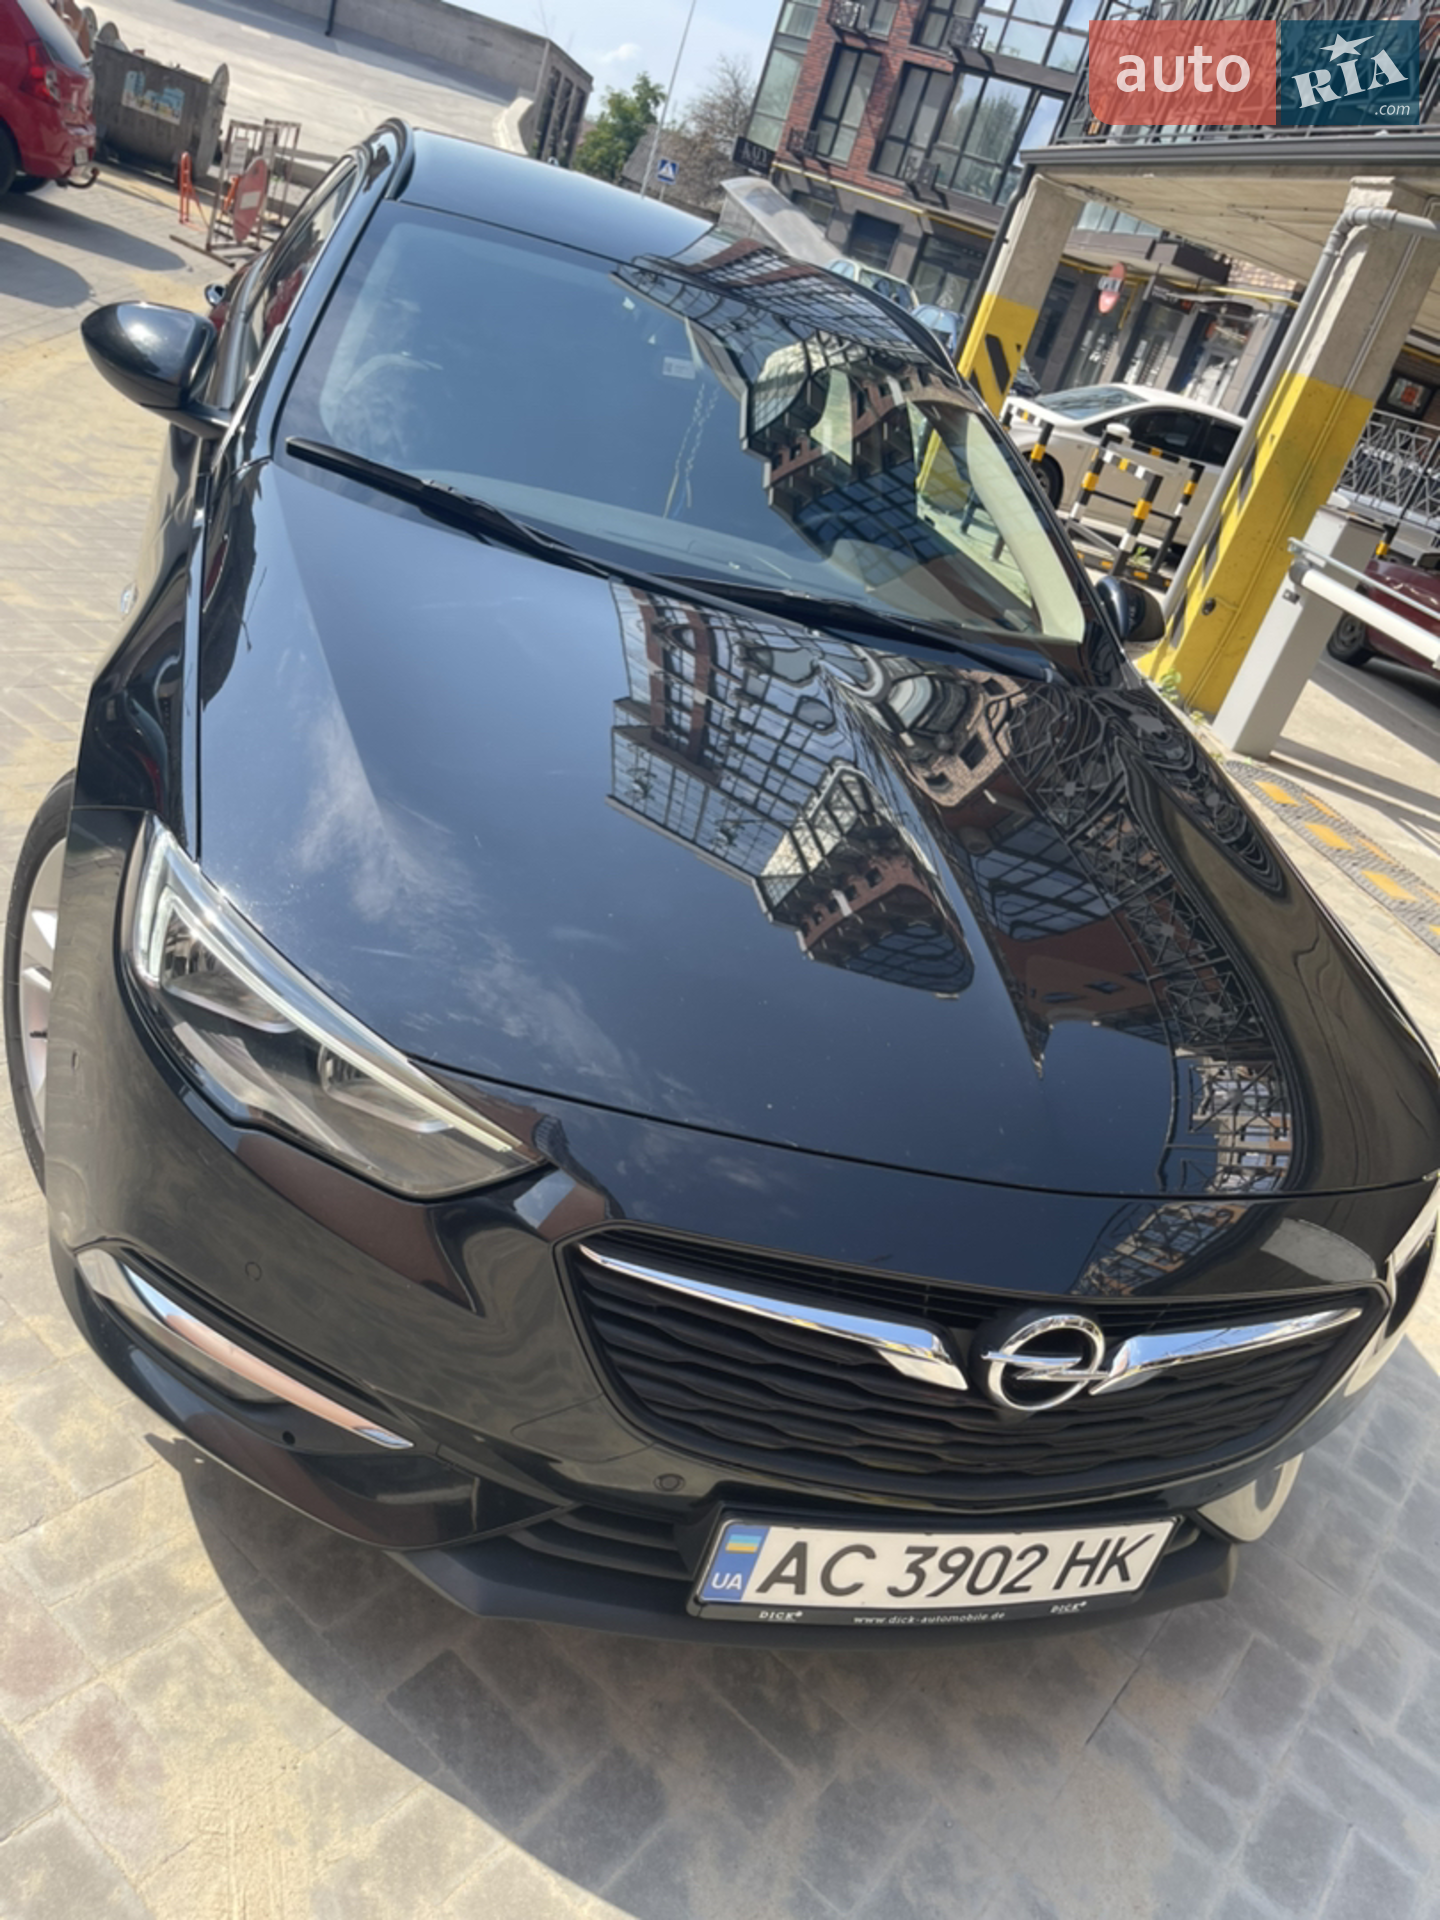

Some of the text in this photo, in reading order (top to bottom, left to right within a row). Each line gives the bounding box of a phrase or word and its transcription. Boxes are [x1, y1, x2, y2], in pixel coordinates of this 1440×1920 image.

[755, 1533, 1155, 1598] AC 3902 HK
[711, 1572, 742, 1590] UA
[853, 1611, 1006, 1625] www.dick-automobile.de
